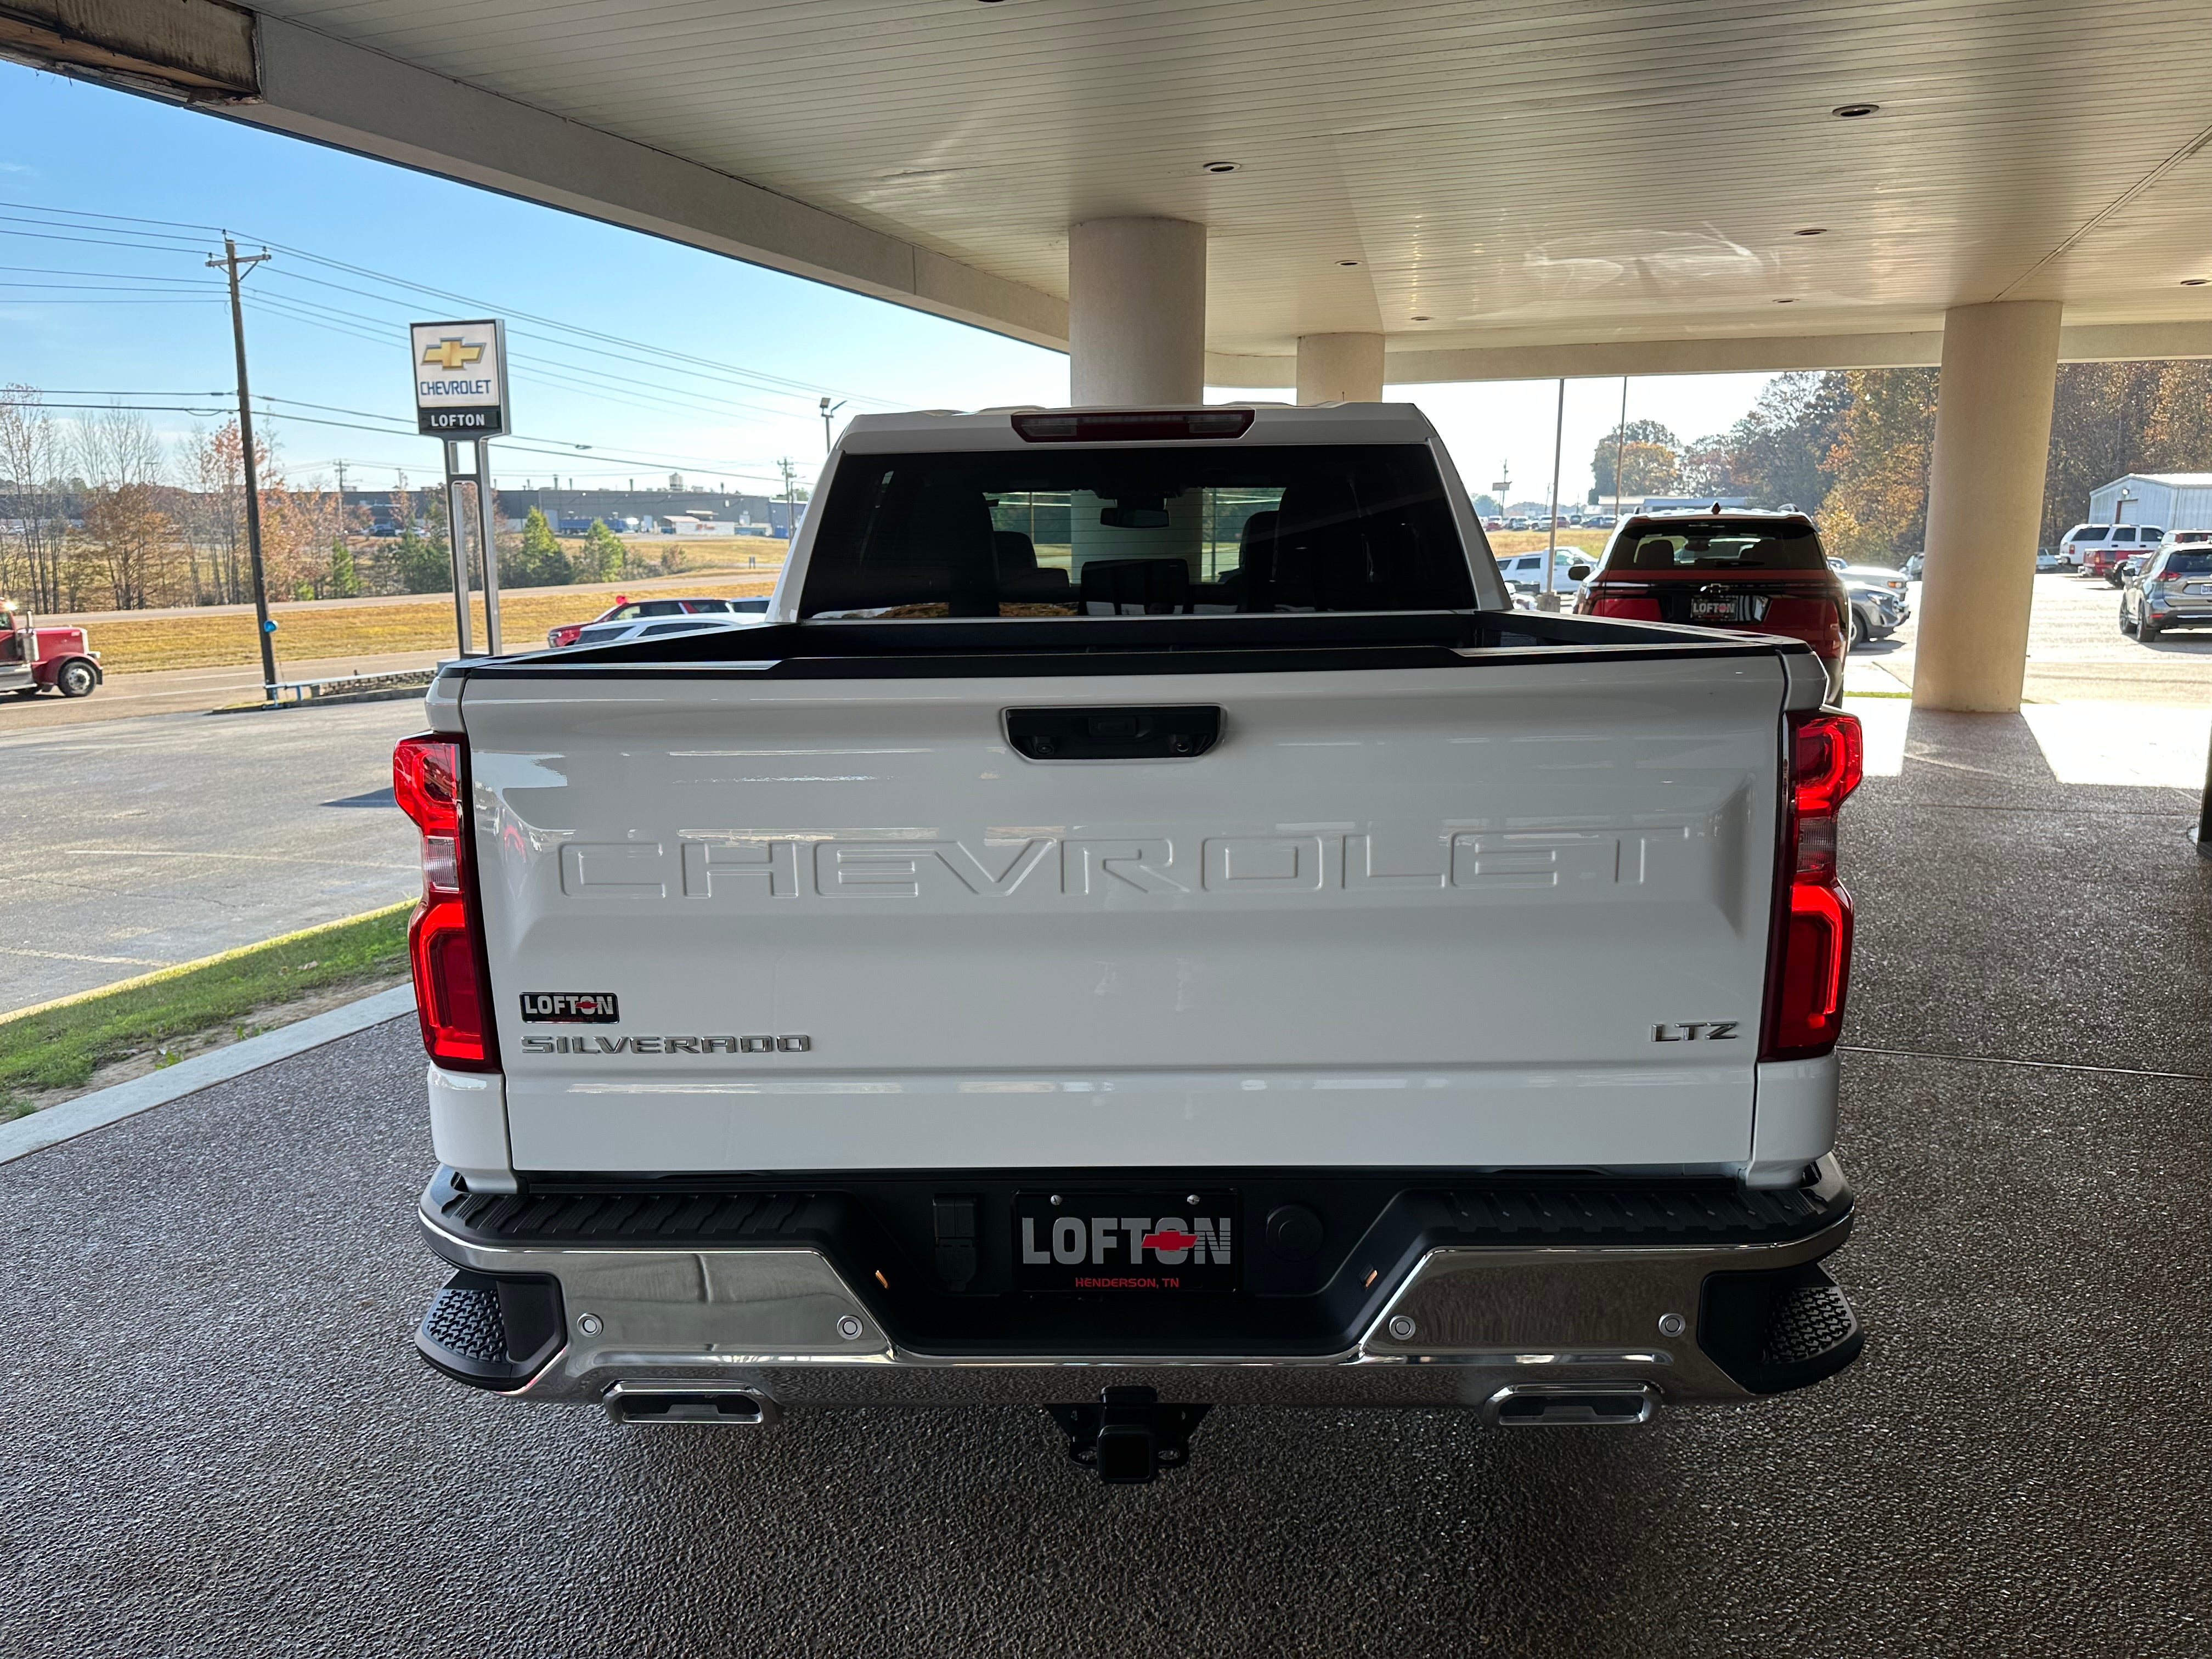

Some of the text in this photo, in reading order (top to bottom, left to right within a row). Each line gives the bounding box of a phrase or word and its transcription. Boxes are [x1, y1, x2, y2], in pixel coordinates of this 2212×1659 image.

[420, 380, 491, 395] CHEVROLET
[431, 414, 484, 427] LOFTON
[1692, 602, 1735, 613] LOFTON
[558, 826, 1690, 899] CHEVROLET
[524, 995, 614, 1015] LOFTON
[1651, 1021, 1738, 1042] LTZ
[521, 1035, 811, 1054] SILVERADO
[1022, 1217, 1231, 1265] LOFTON
[1075, 1278, 1179, 1289] HENDERSON, TN
